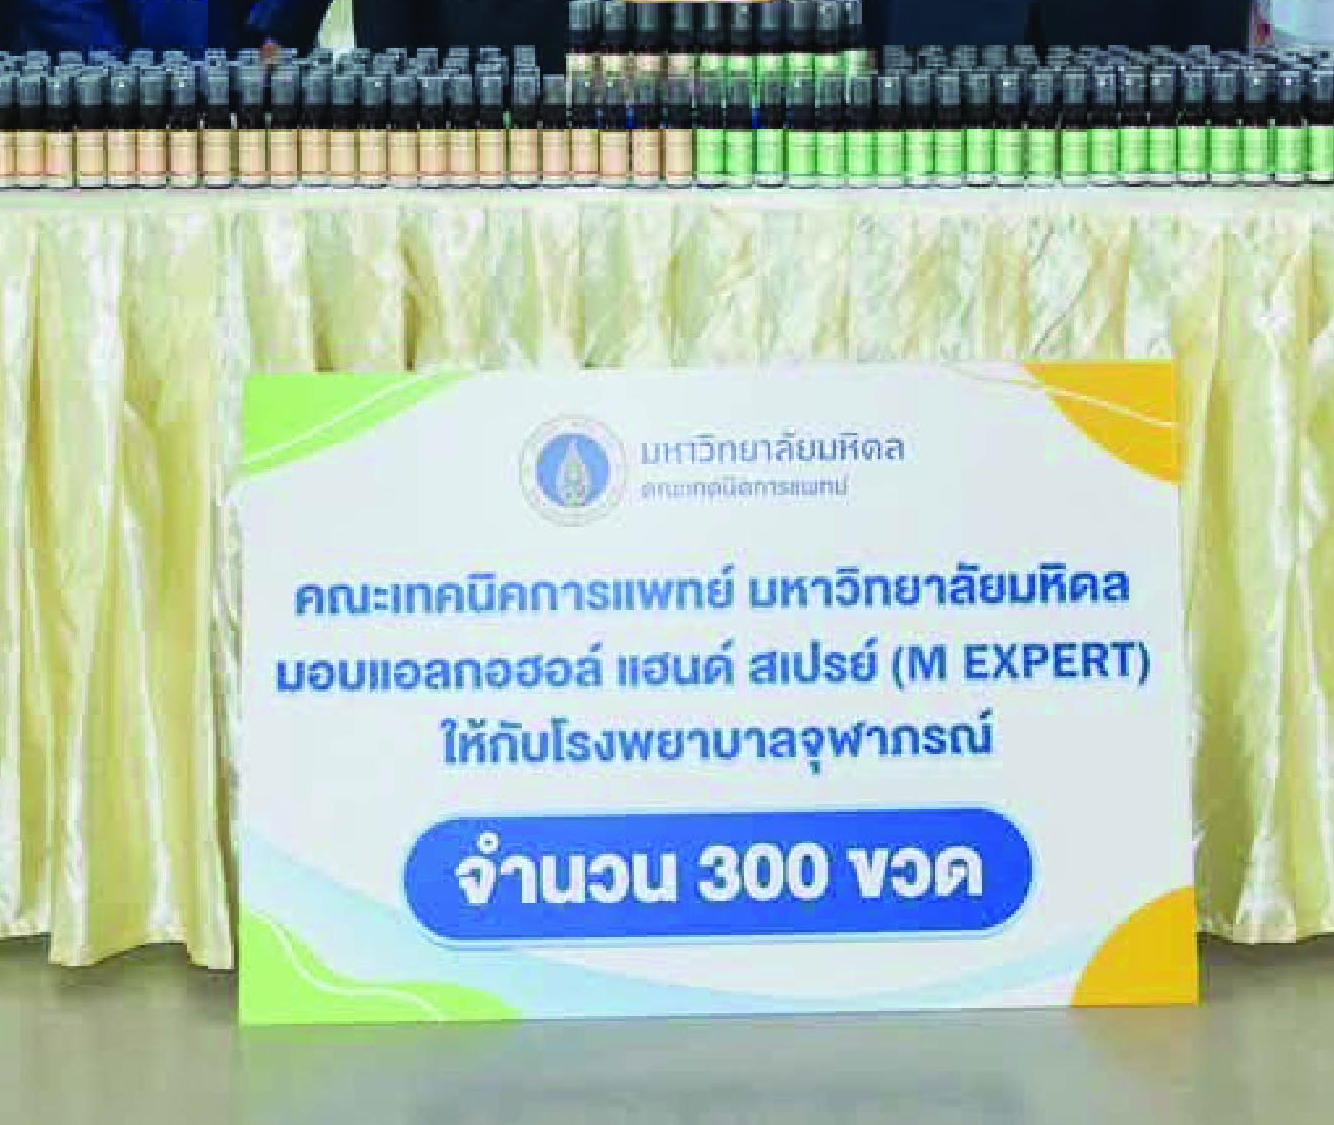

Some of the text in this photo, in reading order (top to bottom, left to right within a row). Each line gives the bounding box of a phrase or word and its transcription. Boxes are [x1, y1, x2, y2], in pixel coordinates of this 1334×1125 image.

[640, 427, 906, 466] มหาวิทยาลัยมหิดล
[294, 560, 1131, 617] คณะเทคนิคการแพทย์ มหาวิทยาลัยมหิดล
[275, 636, 1151, 693] มอบแอลกอฮอล์ แฮนด์ สเปรย์ (M EXPERT)
[439, 706, 994, 774] ให้กับโรงพยาบาลจุฬาภรณ์
[455, 832, 984, 905] จำนวน 300 ขวด
